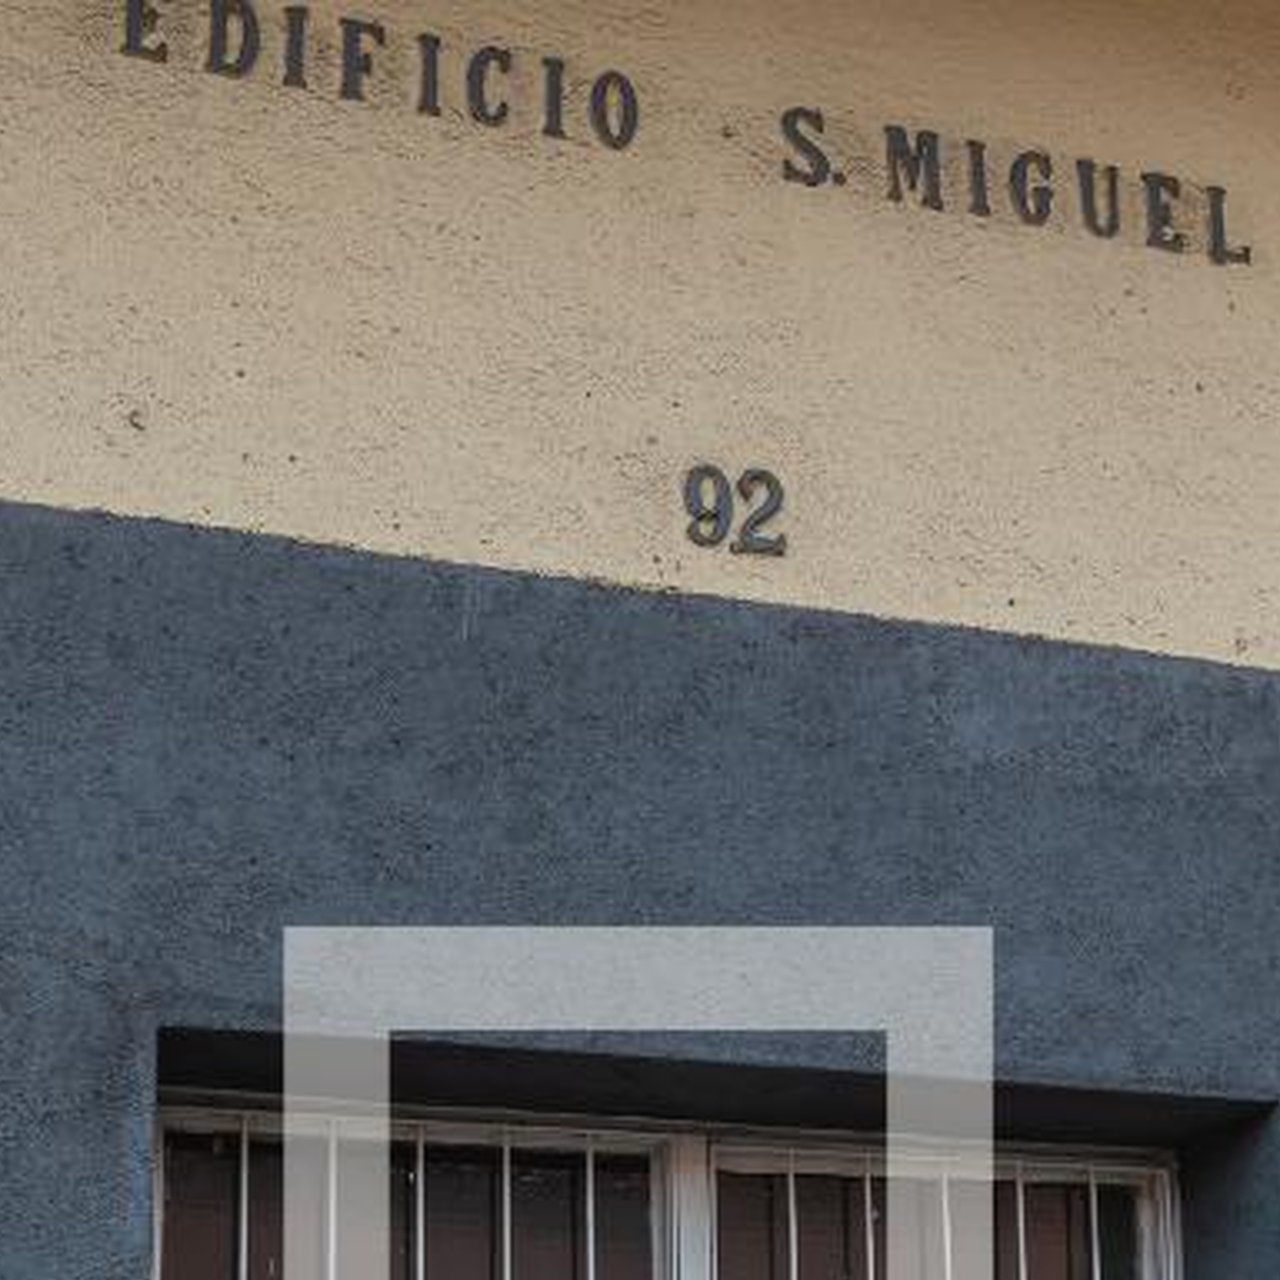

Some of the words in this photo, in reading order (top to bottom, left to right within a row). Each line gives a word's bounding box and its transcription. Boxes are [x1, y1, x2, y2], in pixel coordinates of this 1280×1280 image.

[119, 0, 639, 150] EDIFICIO
[780, 106, 848, 188] S.
[883, 124, 1253, 266] MIGUEL
[681, 462, 788, 557] 92
